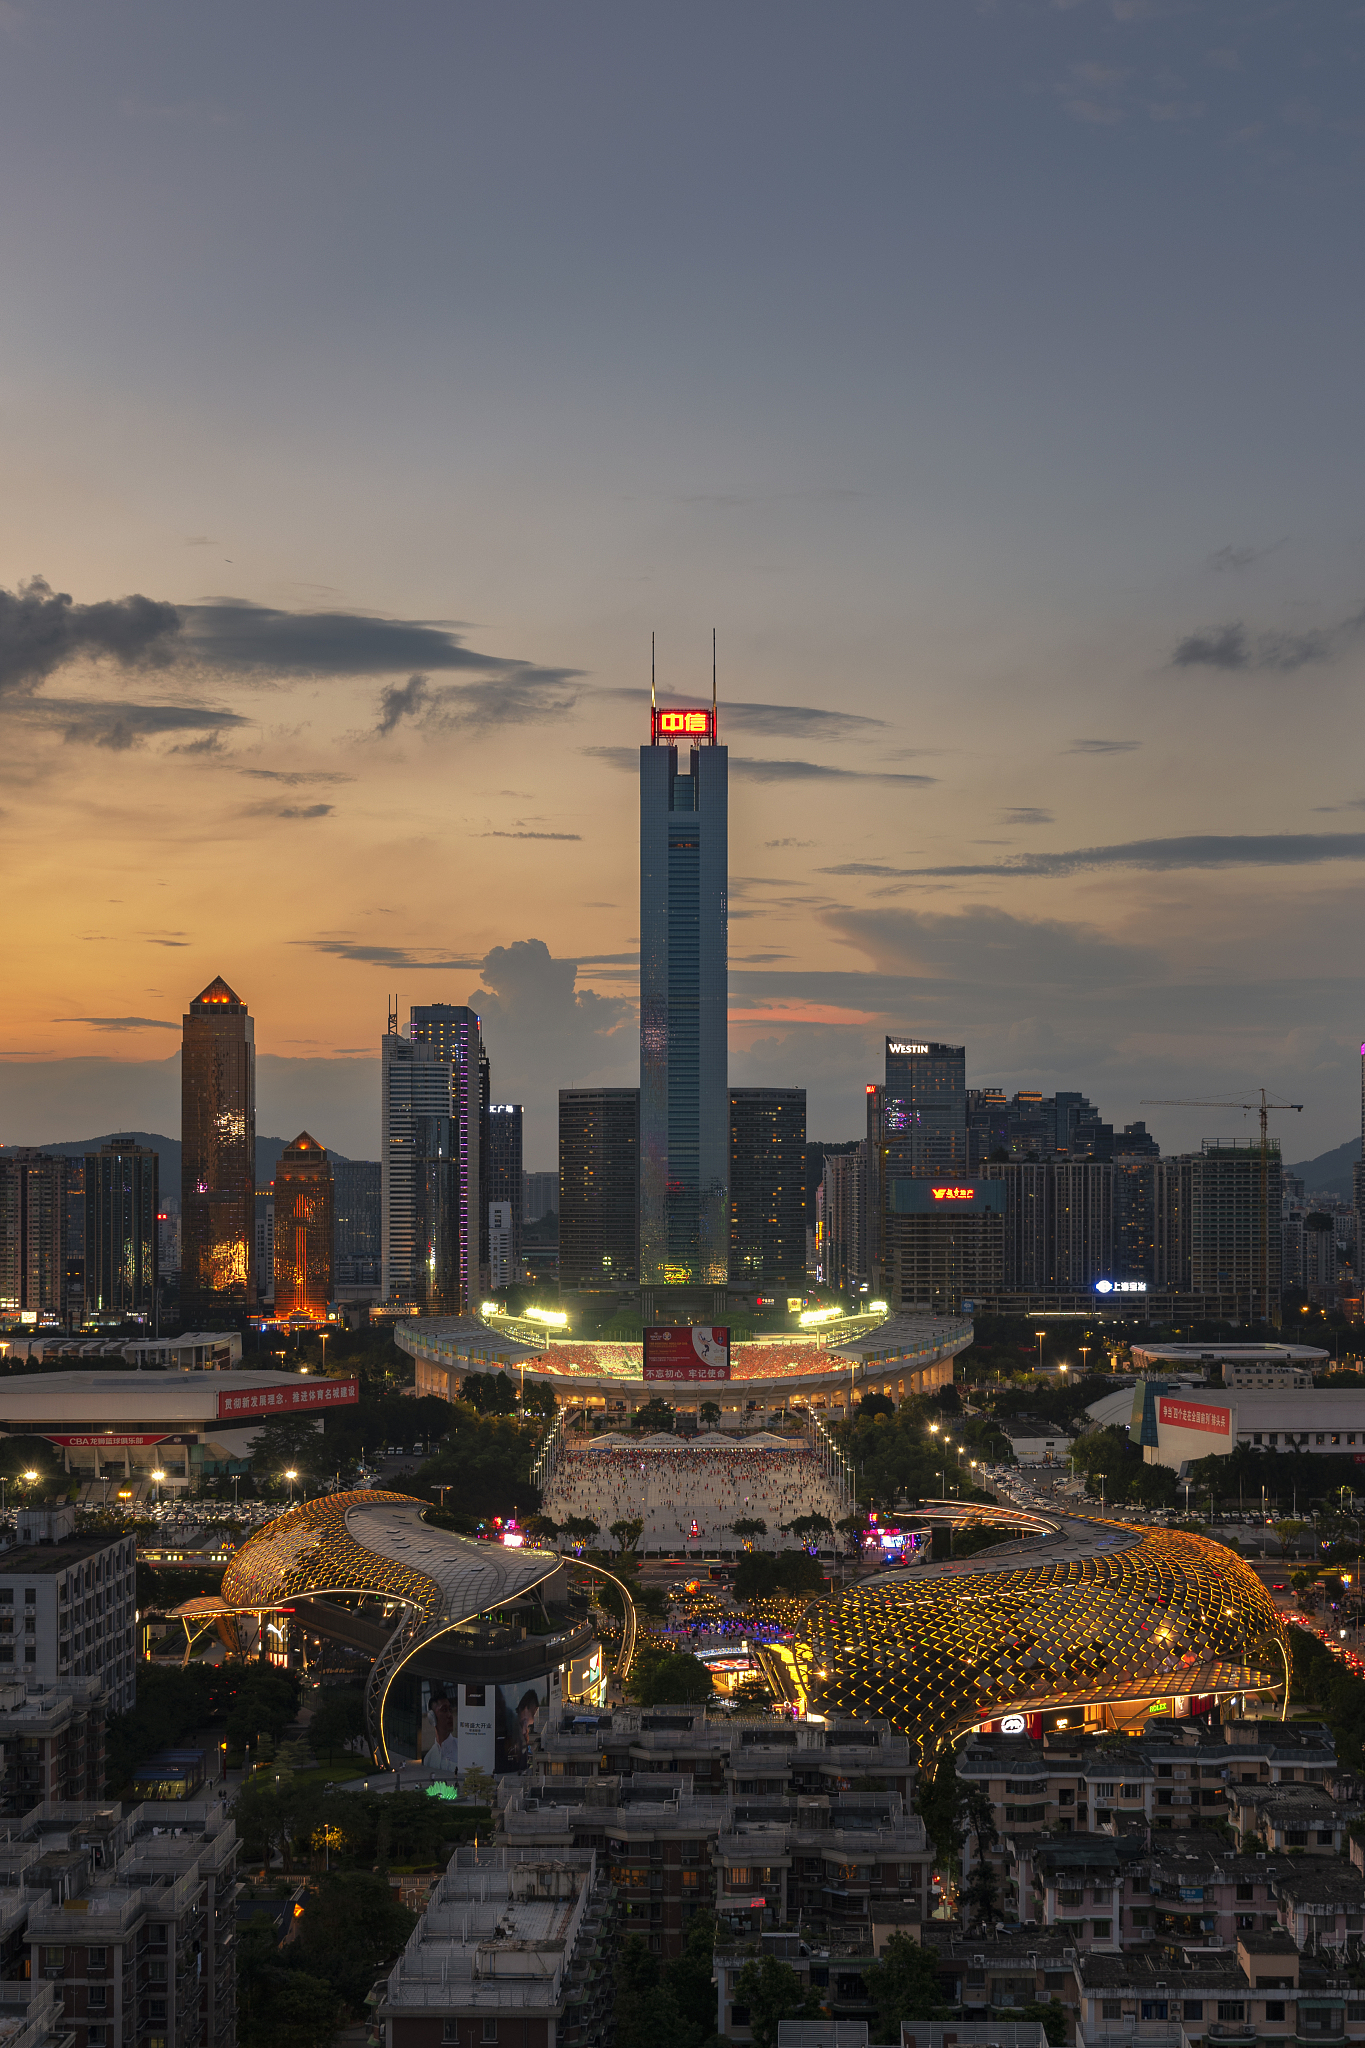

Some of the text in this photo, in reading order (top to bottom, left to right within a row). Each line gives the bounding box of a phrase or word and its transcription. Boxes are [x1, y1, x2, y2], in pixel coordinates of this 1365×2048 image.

[661, 712, 706, 731] 中信
[888, 1043, 929, 1054] WESTIN
[69, 1437, 90, 1445] CBA
[1149, 1702, 1167, 1713] ROLEX
